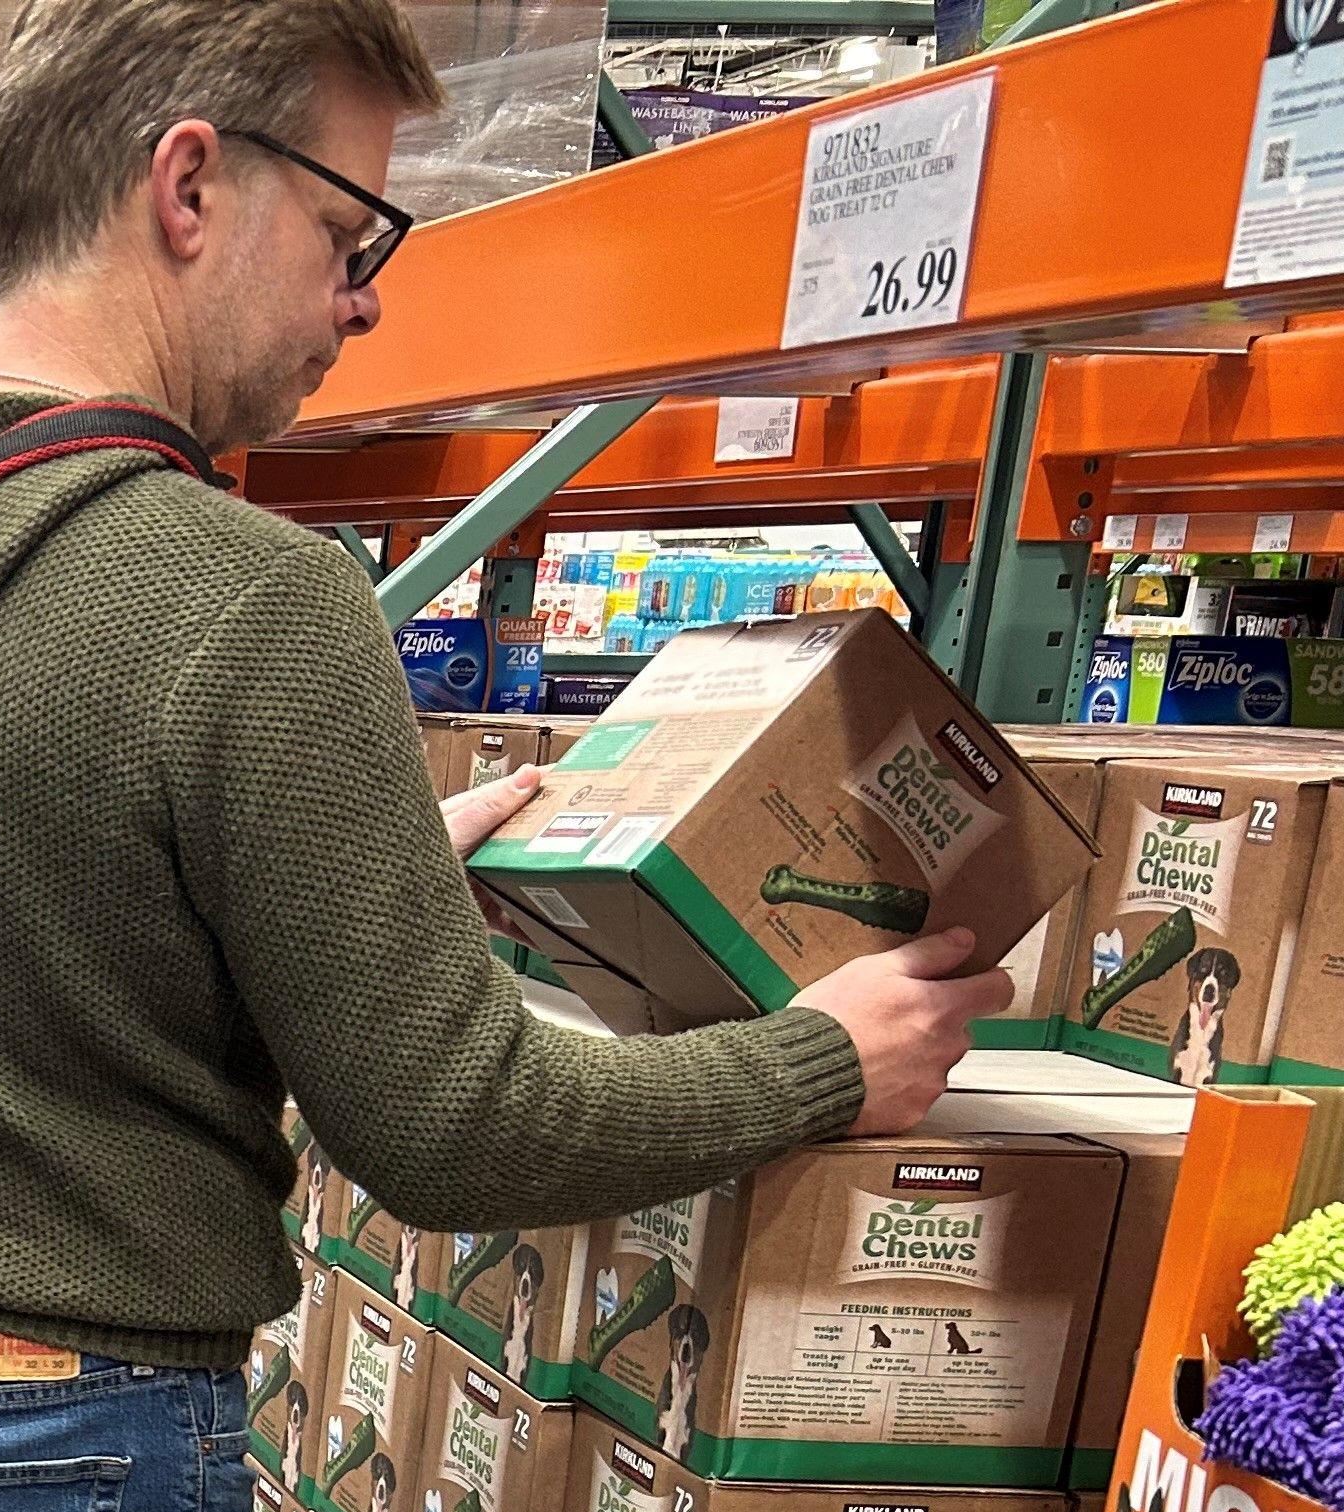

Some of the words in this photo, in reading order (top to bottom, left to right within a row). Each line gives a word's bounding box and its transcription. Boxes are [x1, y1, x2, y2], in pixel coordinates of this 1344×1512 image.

[824, 123, 880, 165] 971832
[812, 151, 867, 183] KIRKLAND
[872, 138, 934, 169] SIGNATURE
[810, 177, 842, 204] GRAIN
[846, 172, 874, 195] FREE
[875, 164, 919, 189] DENTAL
[922, 154, 957, 178] CHEW
[808, 203, 830, 226] DOG
[834, 197, 865, 219] TREAT
[862, 247, 957, 317] 26.99
[746, 584, 771, 598] ICE
[500, 621, 544, 632] QUART
[504, 632, 542, 641] FREEZER
[402, 633, 455, 658] Ziploc
[507, 647, 539, 665] 216
[1094, 656, 1128, 680] Ziploc
[1138, 654, 1165, 672] 580
[1178, 656, 1253, 691] Ziploc
[944, 723, 1000, 785] KIRKLAND
[892, 745, 973, 835] Dental
[1166, 786, 1223, 807] KIRKLAND
[878, 758, 950, 851] Chews
[1251, 800, 1277, 829] 72
[1142, 832, 1221, 868] Dental
[1137, 858, 1214, 895] Chews
[898, 1166, 980, 1182] KIRKLAND
[868, 1211, 983, 1239] Dental
[862, 1234, 977, 1261] Chews
[852, 1260, 907, 1272] GRAIN-FREE
[918, 1260, 977, 1277] GLUTEN-FREE
[841, 1304, 889, 1315] FEEDING
[892, 1306, 972, 1318] INSTRUCTIONS
[614, 1442, 654, 1481] KIRKLAND
